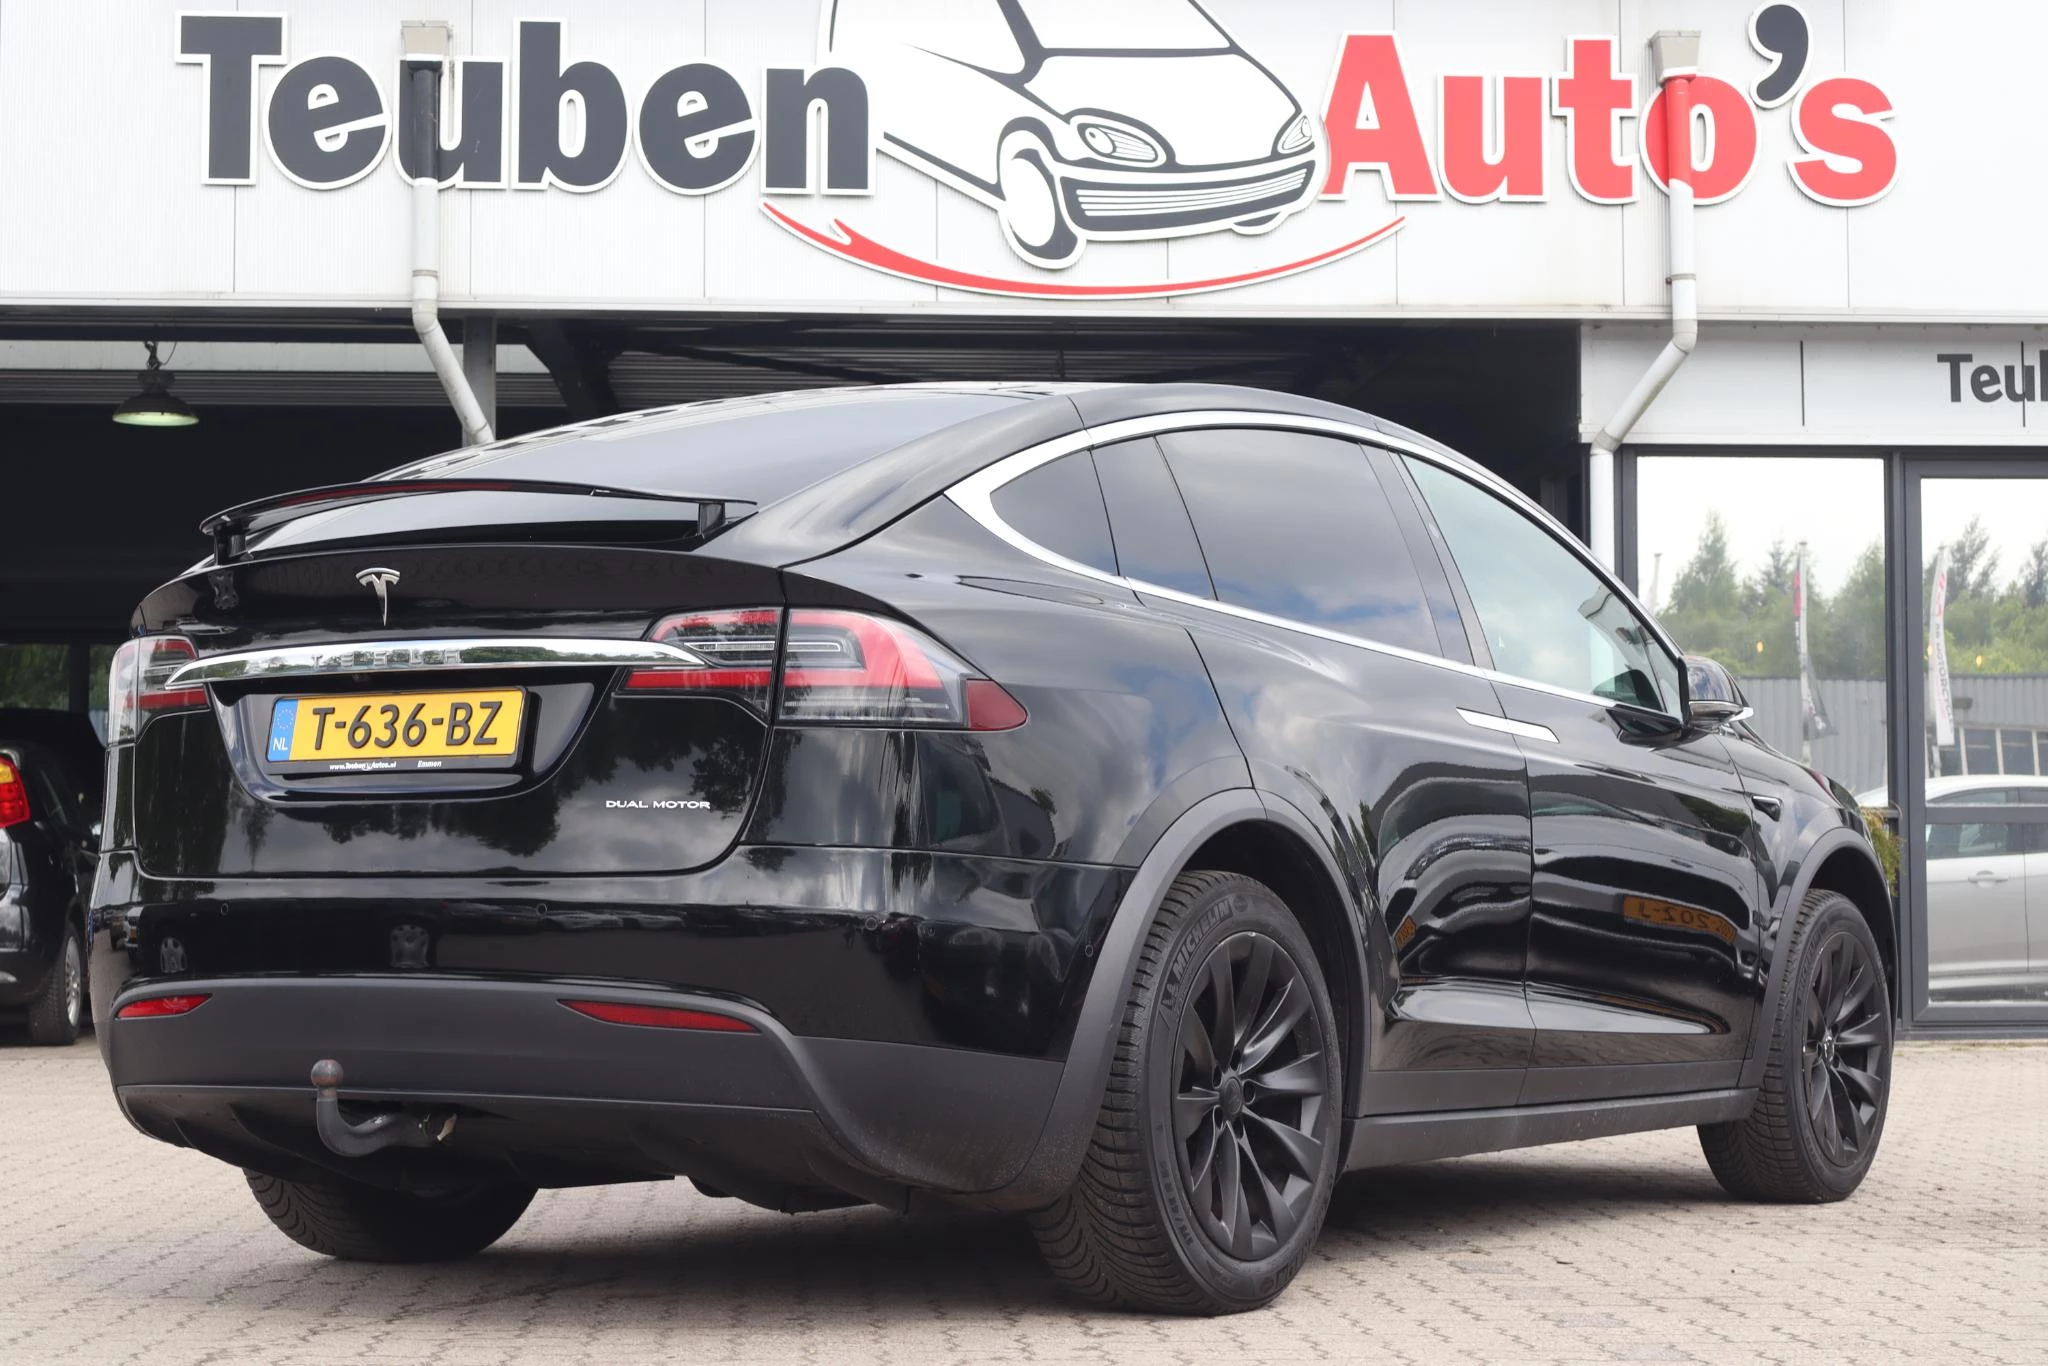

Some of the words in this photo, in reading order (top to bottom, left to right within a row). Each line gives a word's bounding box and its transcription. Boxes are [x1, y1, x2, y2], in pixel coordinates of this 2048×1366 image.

[179, 15, 870, 193] Teuben
[1320, 4, 1898, 202] Auto's
[312, 701, 503, 751] T-636-BZ
[272, 737, 289, 751] NL
[417, 760, 442, 768] Emmen
[605, 800, 649, 809] DUAL
[653, 800, 711, 809] MOTOR
[1172, 898, 1232, 981] MICHELIN
